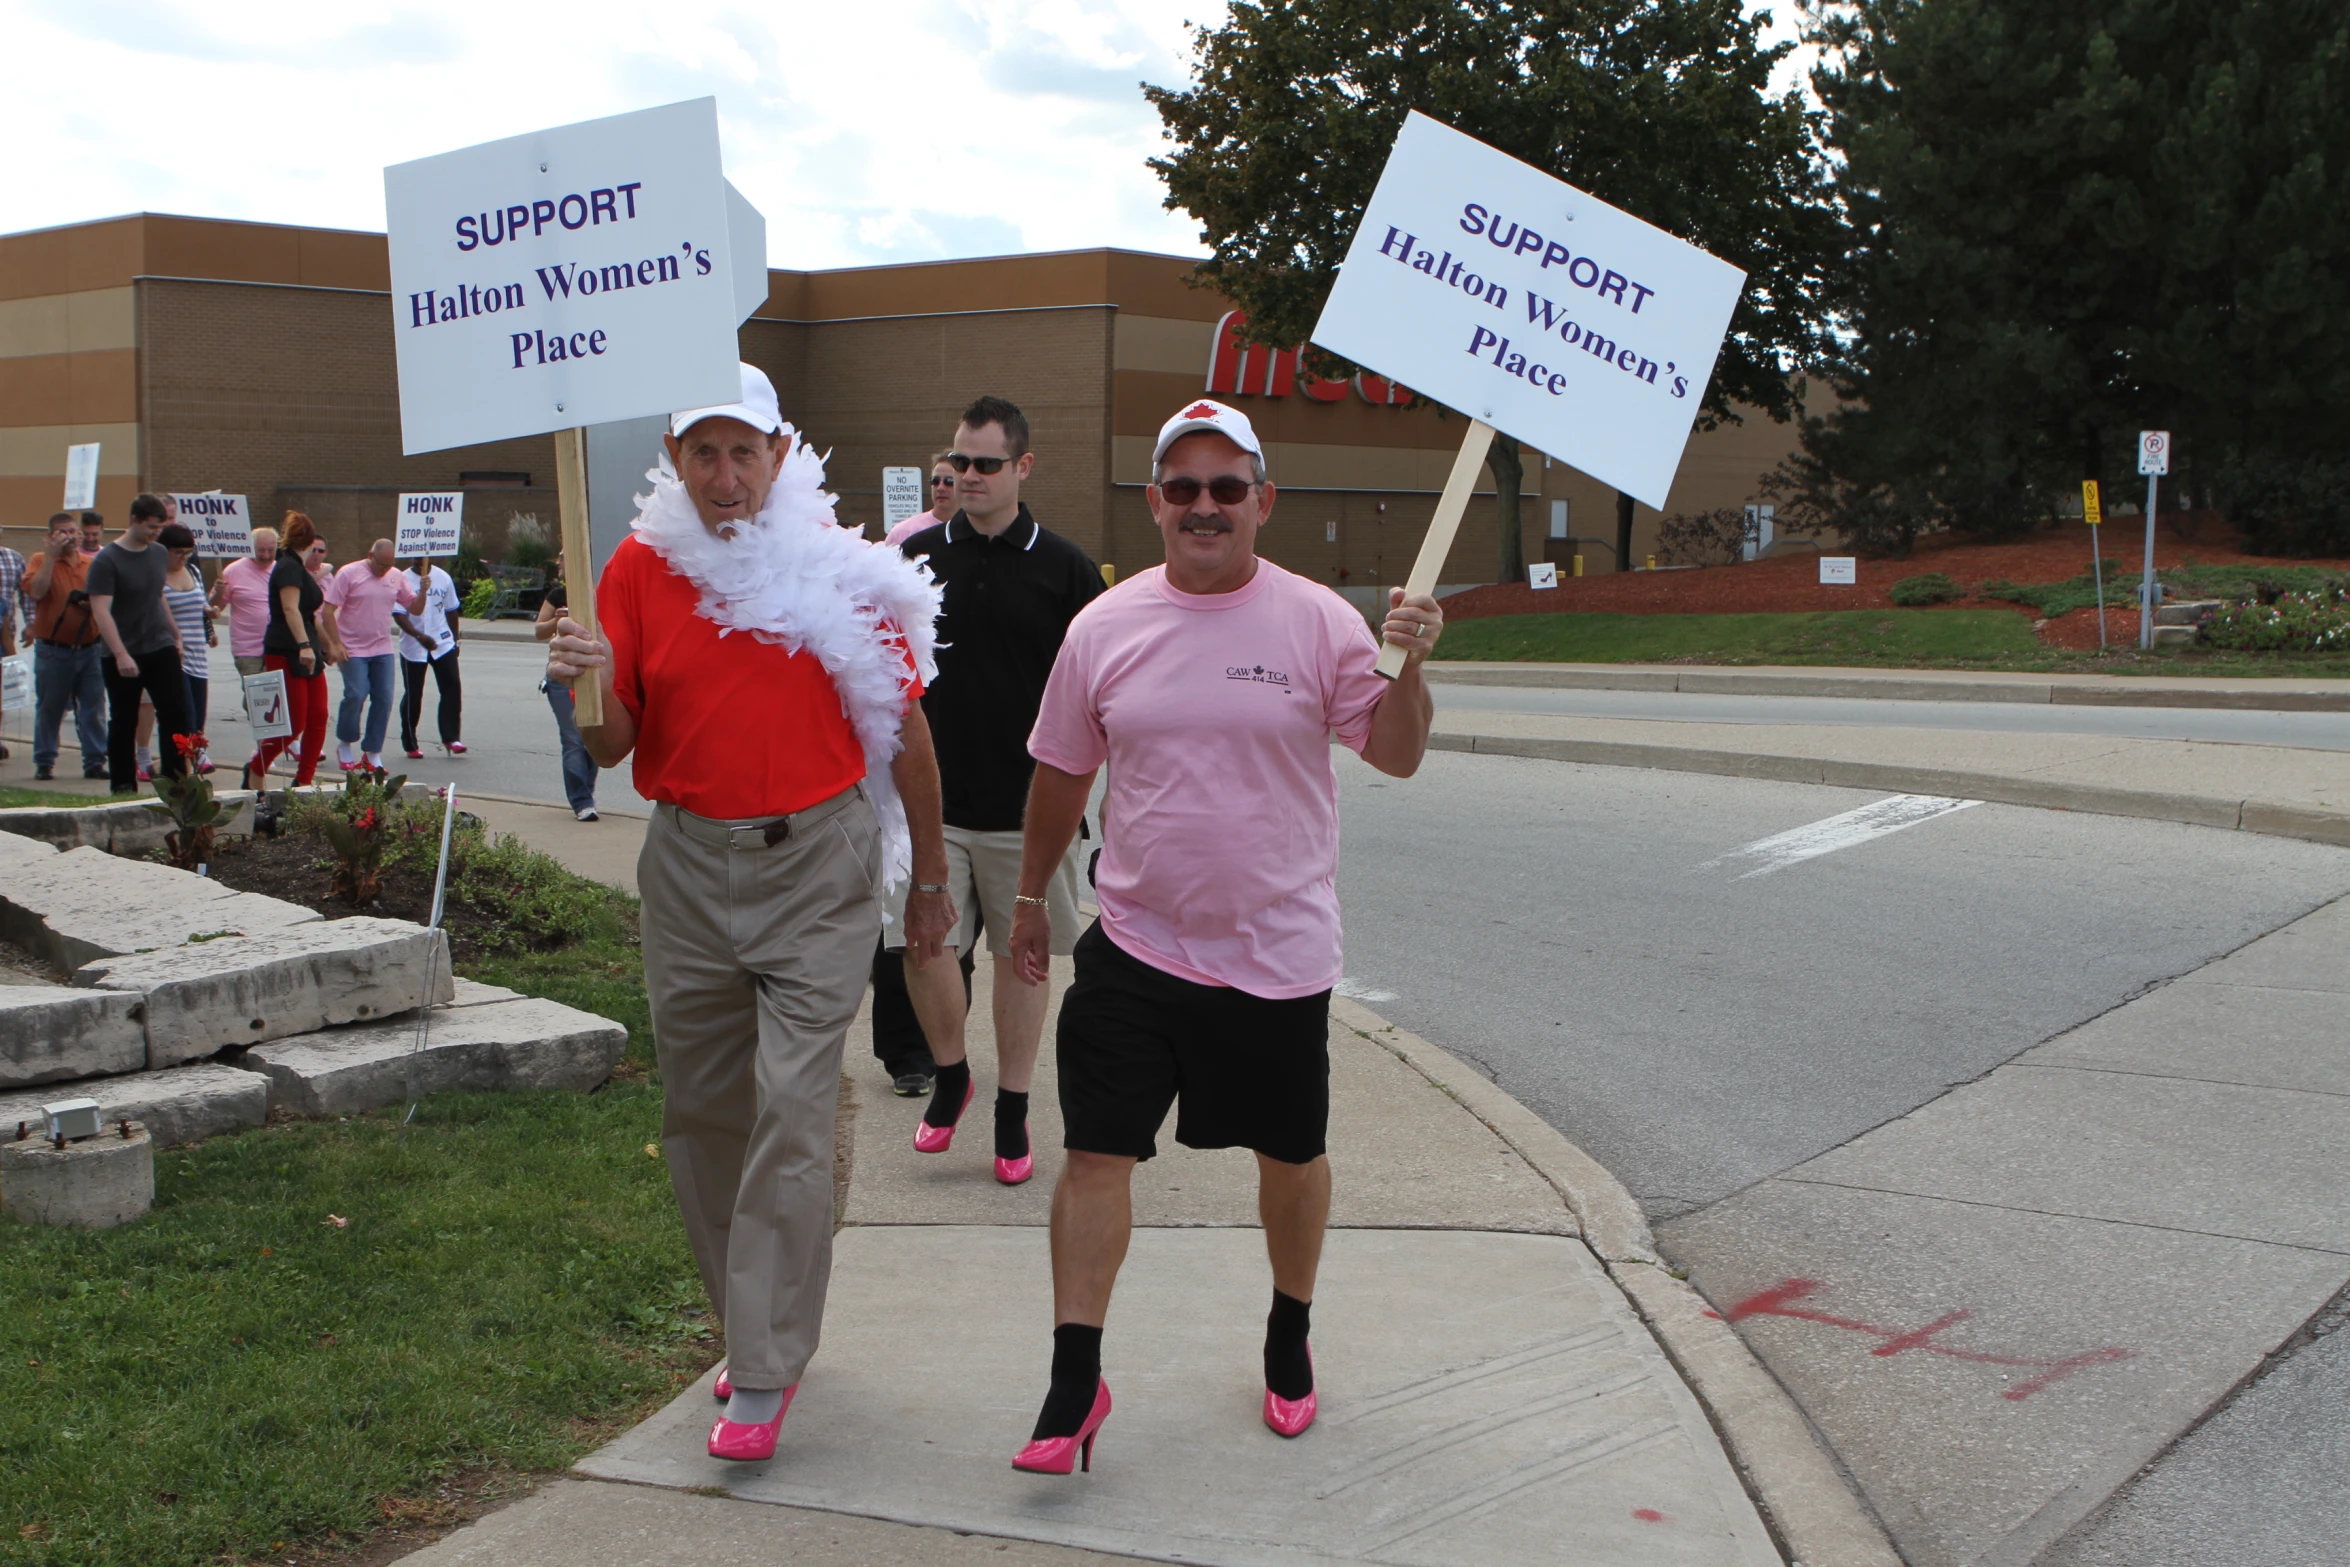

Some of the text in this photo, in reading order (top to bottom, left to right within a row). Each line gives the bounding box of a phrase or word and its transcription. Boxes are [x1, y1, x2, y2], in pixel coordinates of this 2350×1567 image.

[456, 182, 642, 252] SUPPORT
[1459, 203, 1655, 315] SUPPORT
[409, 241, 713, 328] Halton Women's
[1377, 225, 1690, 399] Halton Women's
[510, 329, 607, 369] Place
[1465, 325, 1567, 396] Place
[887, 485, 919, 493] OVERNITE
[179, 498, 238, 515] HONK
[407, 496, 454, 514] HONK
[205, 516, 218, 527] to
[425, 515, 435, 525] to
[192, 529, 247, 541] OP Violence
[401, 528, 456, 539] STOP Violence
[197, 542, 252, 554] inst Women
[398, 541, 456, 554] Against Women
[1226, 666, 1288, 682] CAW TCA
[1252, 675, 1265, 683] 414
